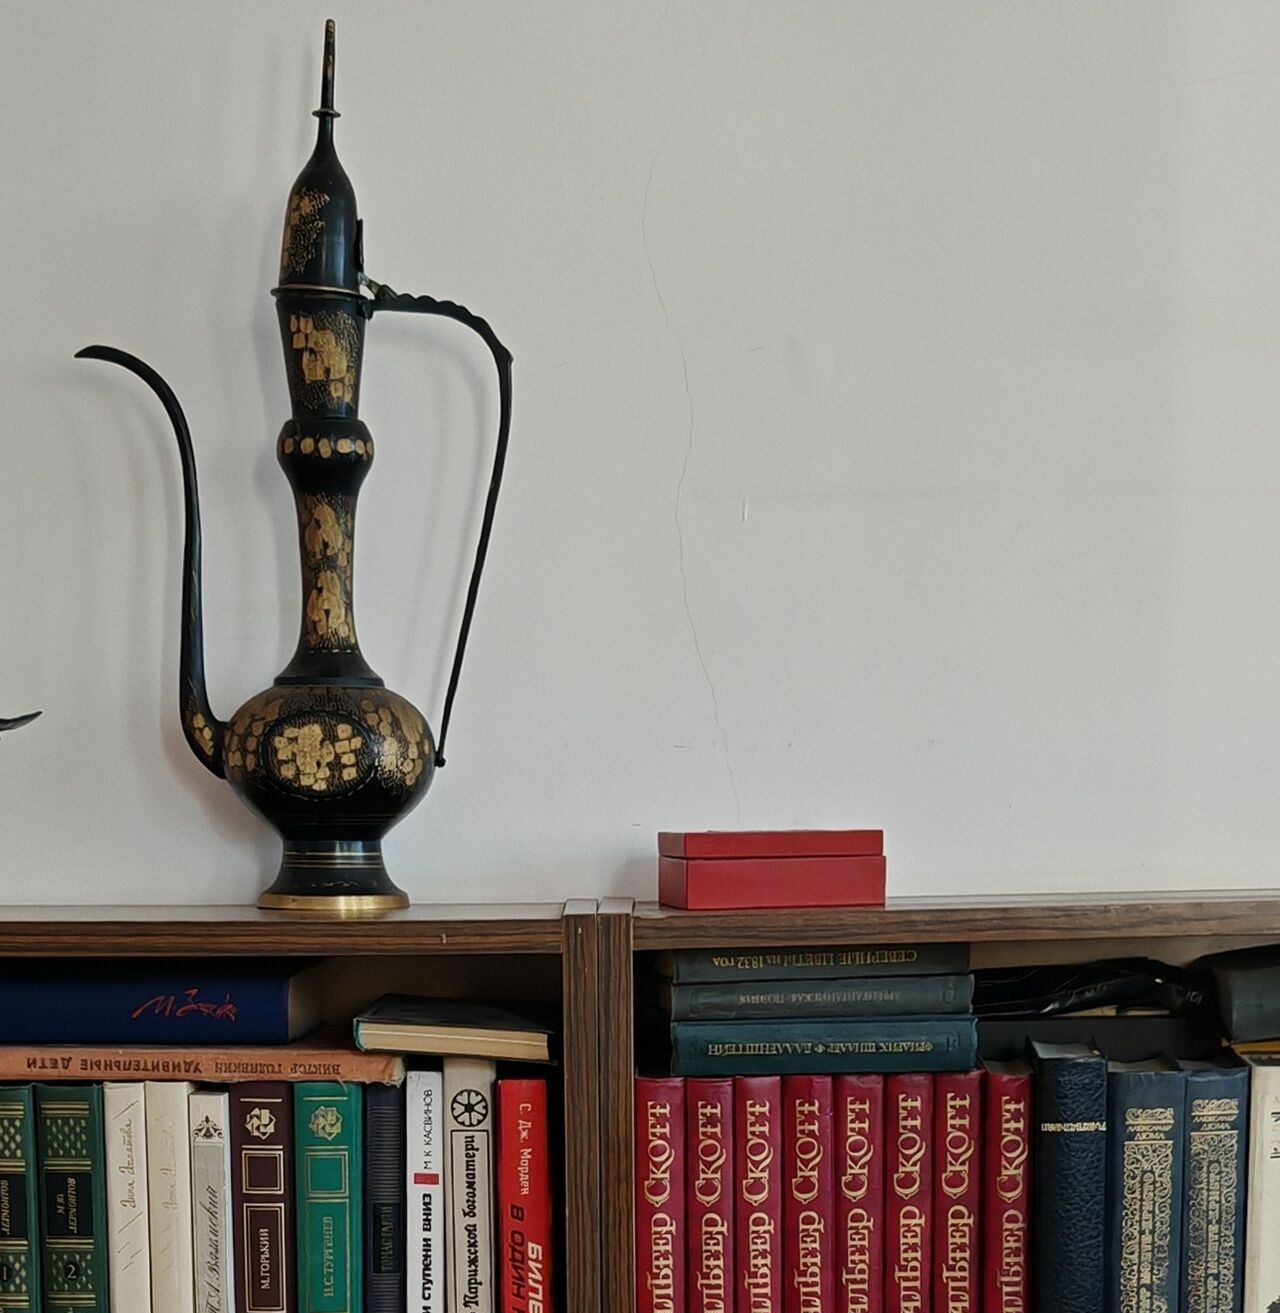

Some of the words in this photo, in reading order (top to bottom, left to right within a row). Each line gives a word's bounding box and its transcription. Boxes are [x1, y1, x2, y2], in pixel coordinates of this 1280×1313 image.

[737, 955, 765, 968] 1832
[26, 1056, 73, 1071] ДЕТИ
[80, 1058, 203, 1075] УДИВИТЕЛЬНЫЕ
[422, 1089, 434, 1146] КАСВИНОВ
[643, 1100, 675, 1208] СКОТТ
[694, 1100, 726, 1208] СКОТТ
[742, 1099, 773, 1206] СКОТТ
[792, 1098, 823, 1205] СКОТТ
[841, 1096, 873, 1203] СКОТТ
[892, 1094, 926, 1200] СКОТТ
[940, 1092, 975, 1199] СКОТТ
[996, 1095, 1028, 1203] СКОТТ
[460, 1136, 480, 1219] богоматери
[519, 1148, 532, 1195] Морден
[419, 1193, 433, 1232] вниз
[510, 1203, 524, 1221] В
[258, 1228, 272, 1289] М.ГОРЬКИЙ
[419, 1238, 434, 1301] ступени
[461, 1223, 482, 1309] Парижской
[510, 1231, 526, 1300] ОДИН
